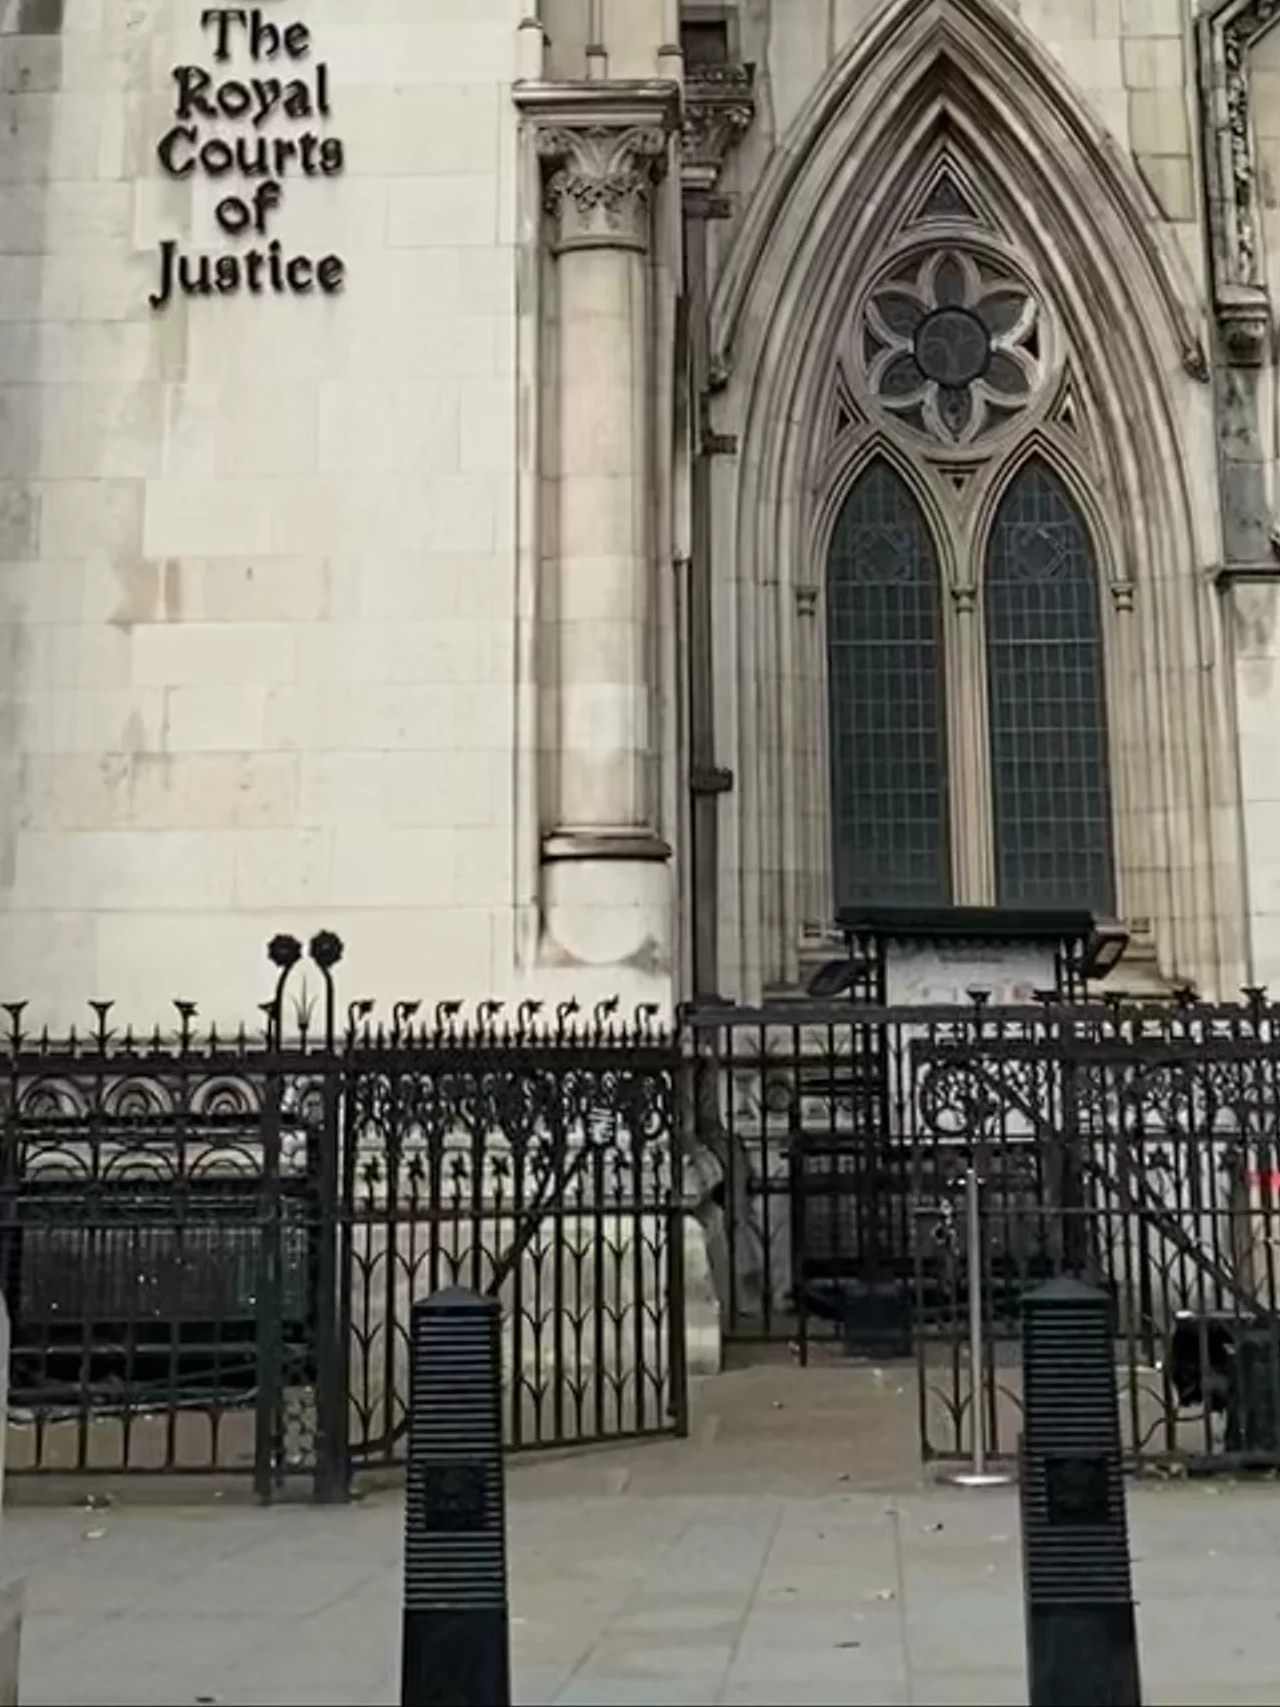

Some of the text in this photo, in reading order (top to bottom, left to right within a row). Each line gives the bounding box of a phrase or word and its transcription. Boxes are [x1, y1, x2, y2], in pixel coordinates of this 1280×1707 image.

[201, 8, 310, 62] The
[172, 62, 329, 128] Royal
[157, 124, 342, 178] Courts
[215, 179, 282, 236] of
[148, 238, 344, 309] Justice
